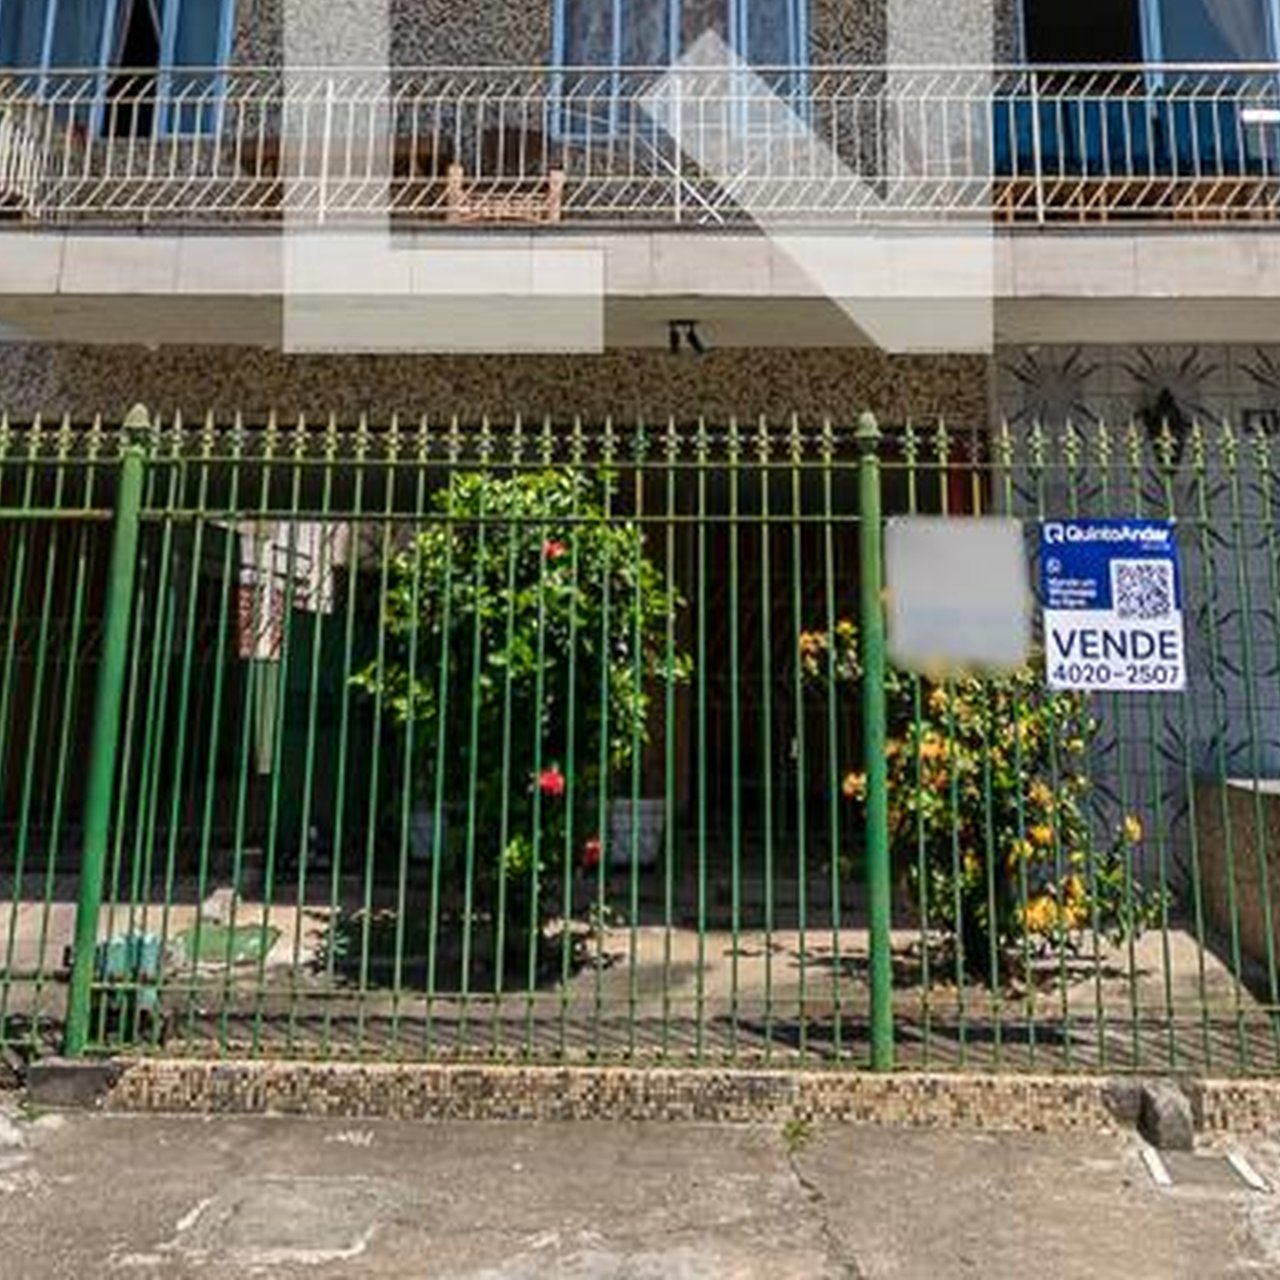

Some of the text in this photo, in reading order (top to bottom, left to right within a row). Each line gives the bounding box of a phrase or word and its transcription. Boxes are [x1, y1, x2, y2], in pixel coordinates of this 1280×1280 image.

[1066, 525, 1169, 542] QuintoAndar
[1052, 629, 1178, 660] VENDE
[1053, 663, 1179, 684] 4020-2507
